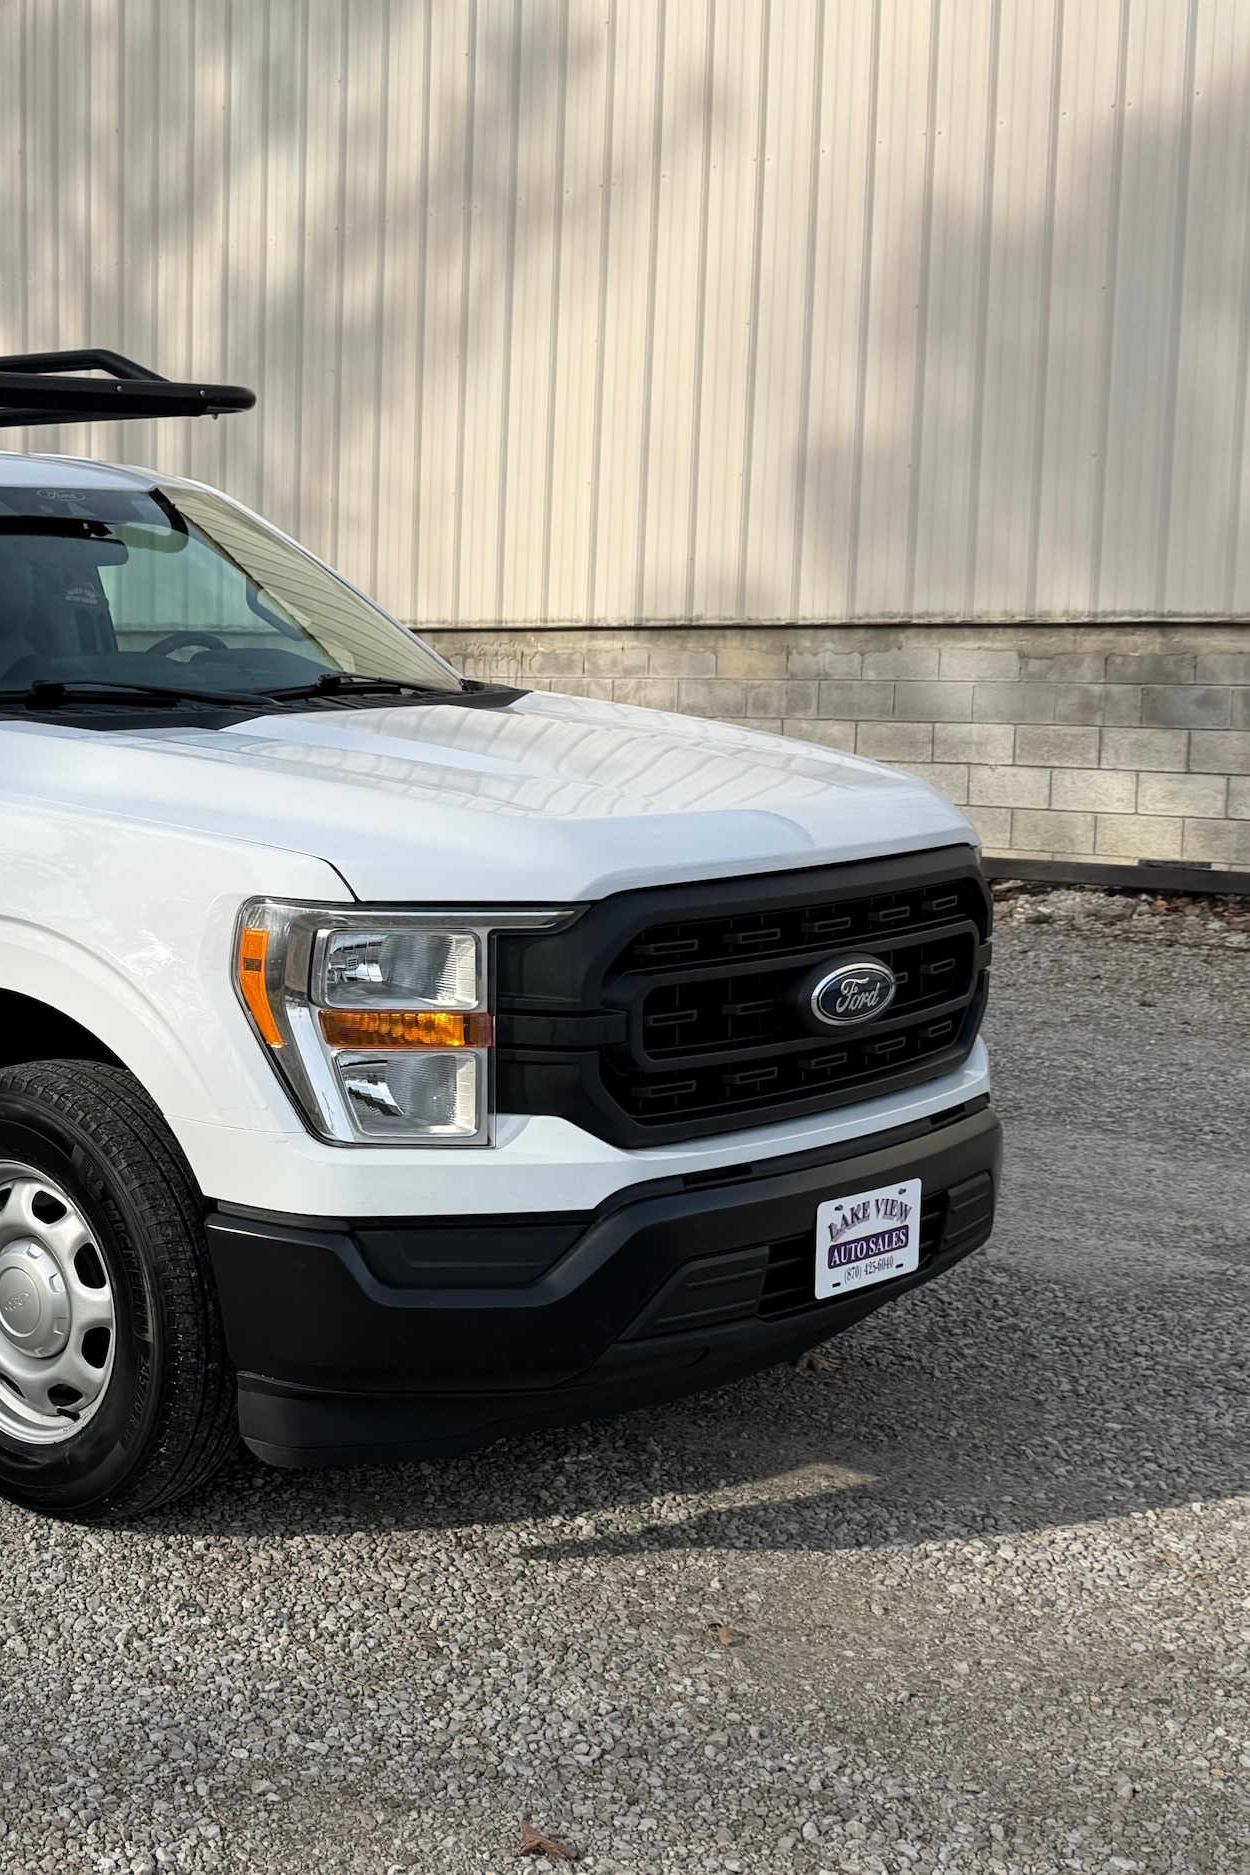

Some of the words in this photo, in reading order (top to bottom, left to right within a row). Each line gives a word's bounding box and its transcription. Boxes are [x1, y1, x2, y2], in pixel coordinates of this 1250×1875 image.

[835, 976, 881, 1014] Ford
[827, 1200, 871, 1243] LAKE
[874, 1198, 912, 1224] VIEW
[830, 1239, 867, 1266] AUTO
[868, 1228, 907, 1255] SALES
[102, 1199, 149, 1335] MICHELIN
[843, 1264, 863, 1283] (870)
[863, 1255, 895, 1276] 425-6040
